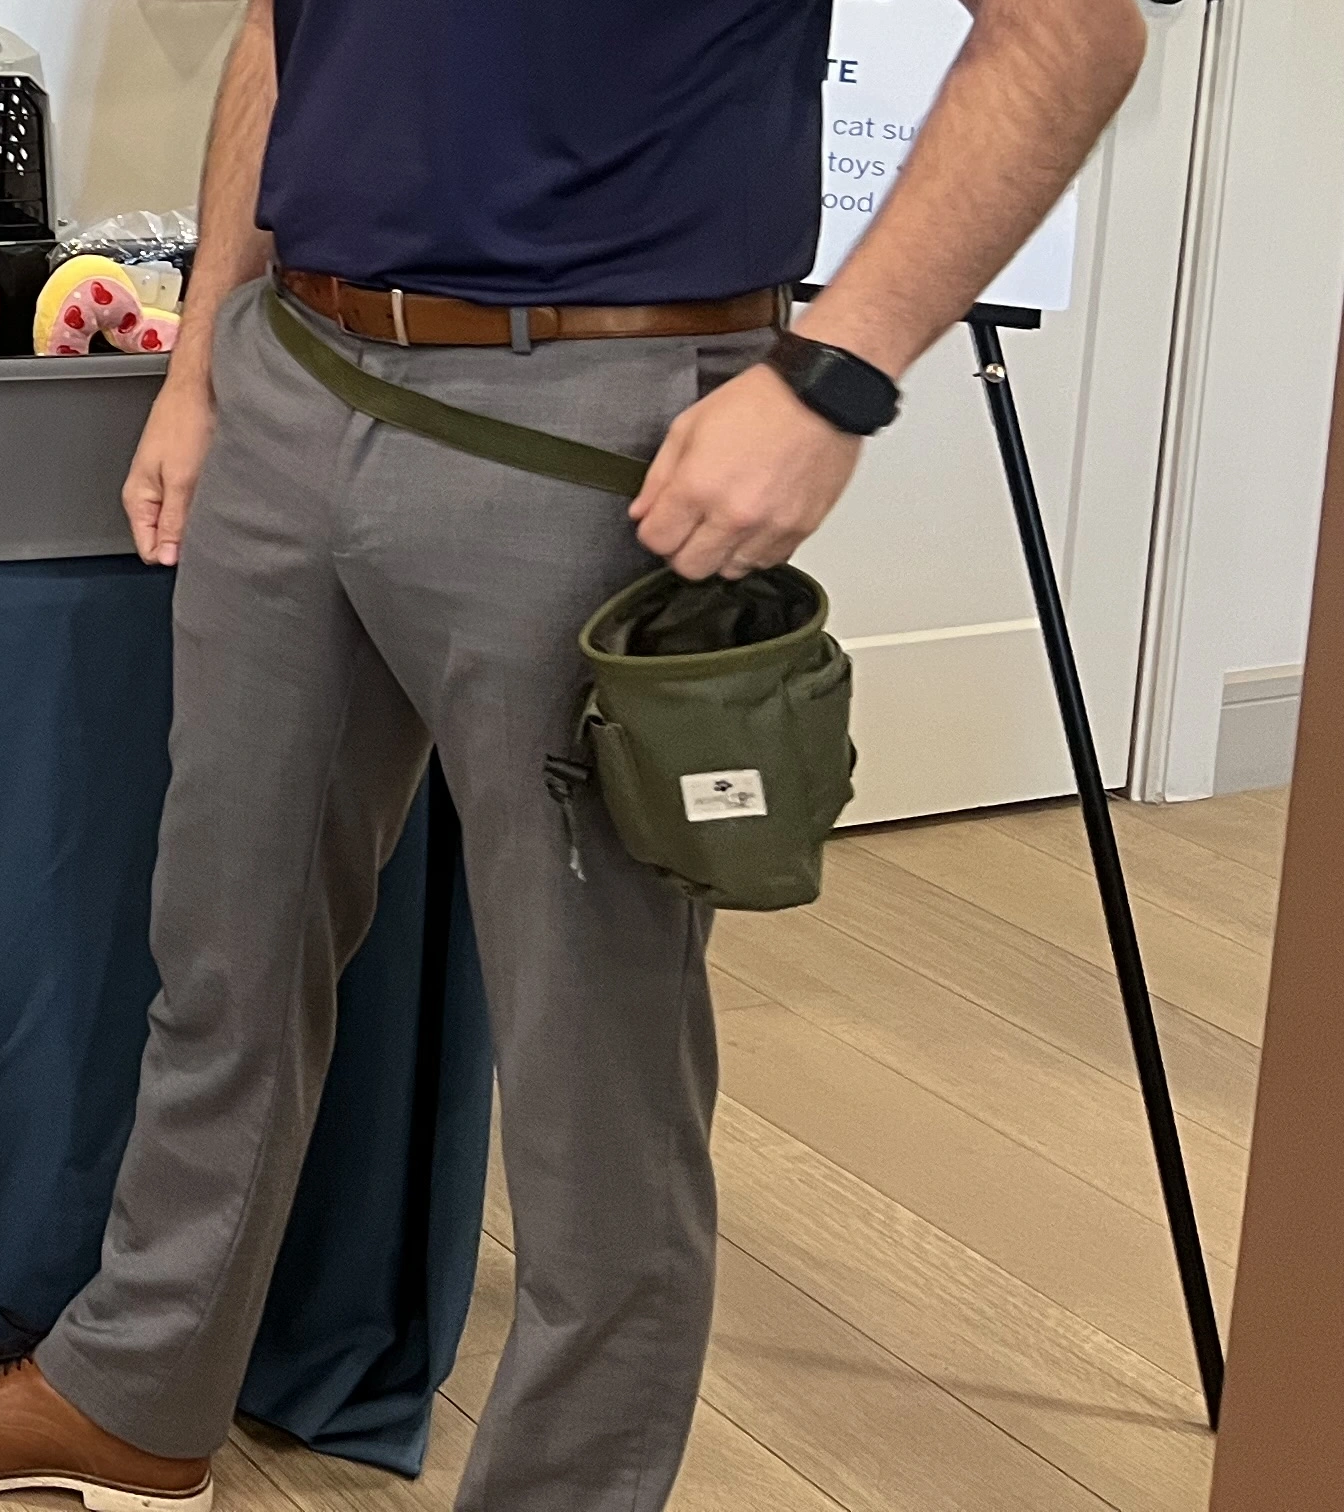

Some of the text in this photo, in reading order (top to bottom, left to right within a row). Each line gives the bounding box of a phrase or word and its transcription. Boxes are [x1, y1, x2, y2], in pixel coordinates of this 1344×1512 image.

[832, 118, 874, 139] cat
[828, 152, 885, 179] toys
[821, 192, 873, 212] ood
